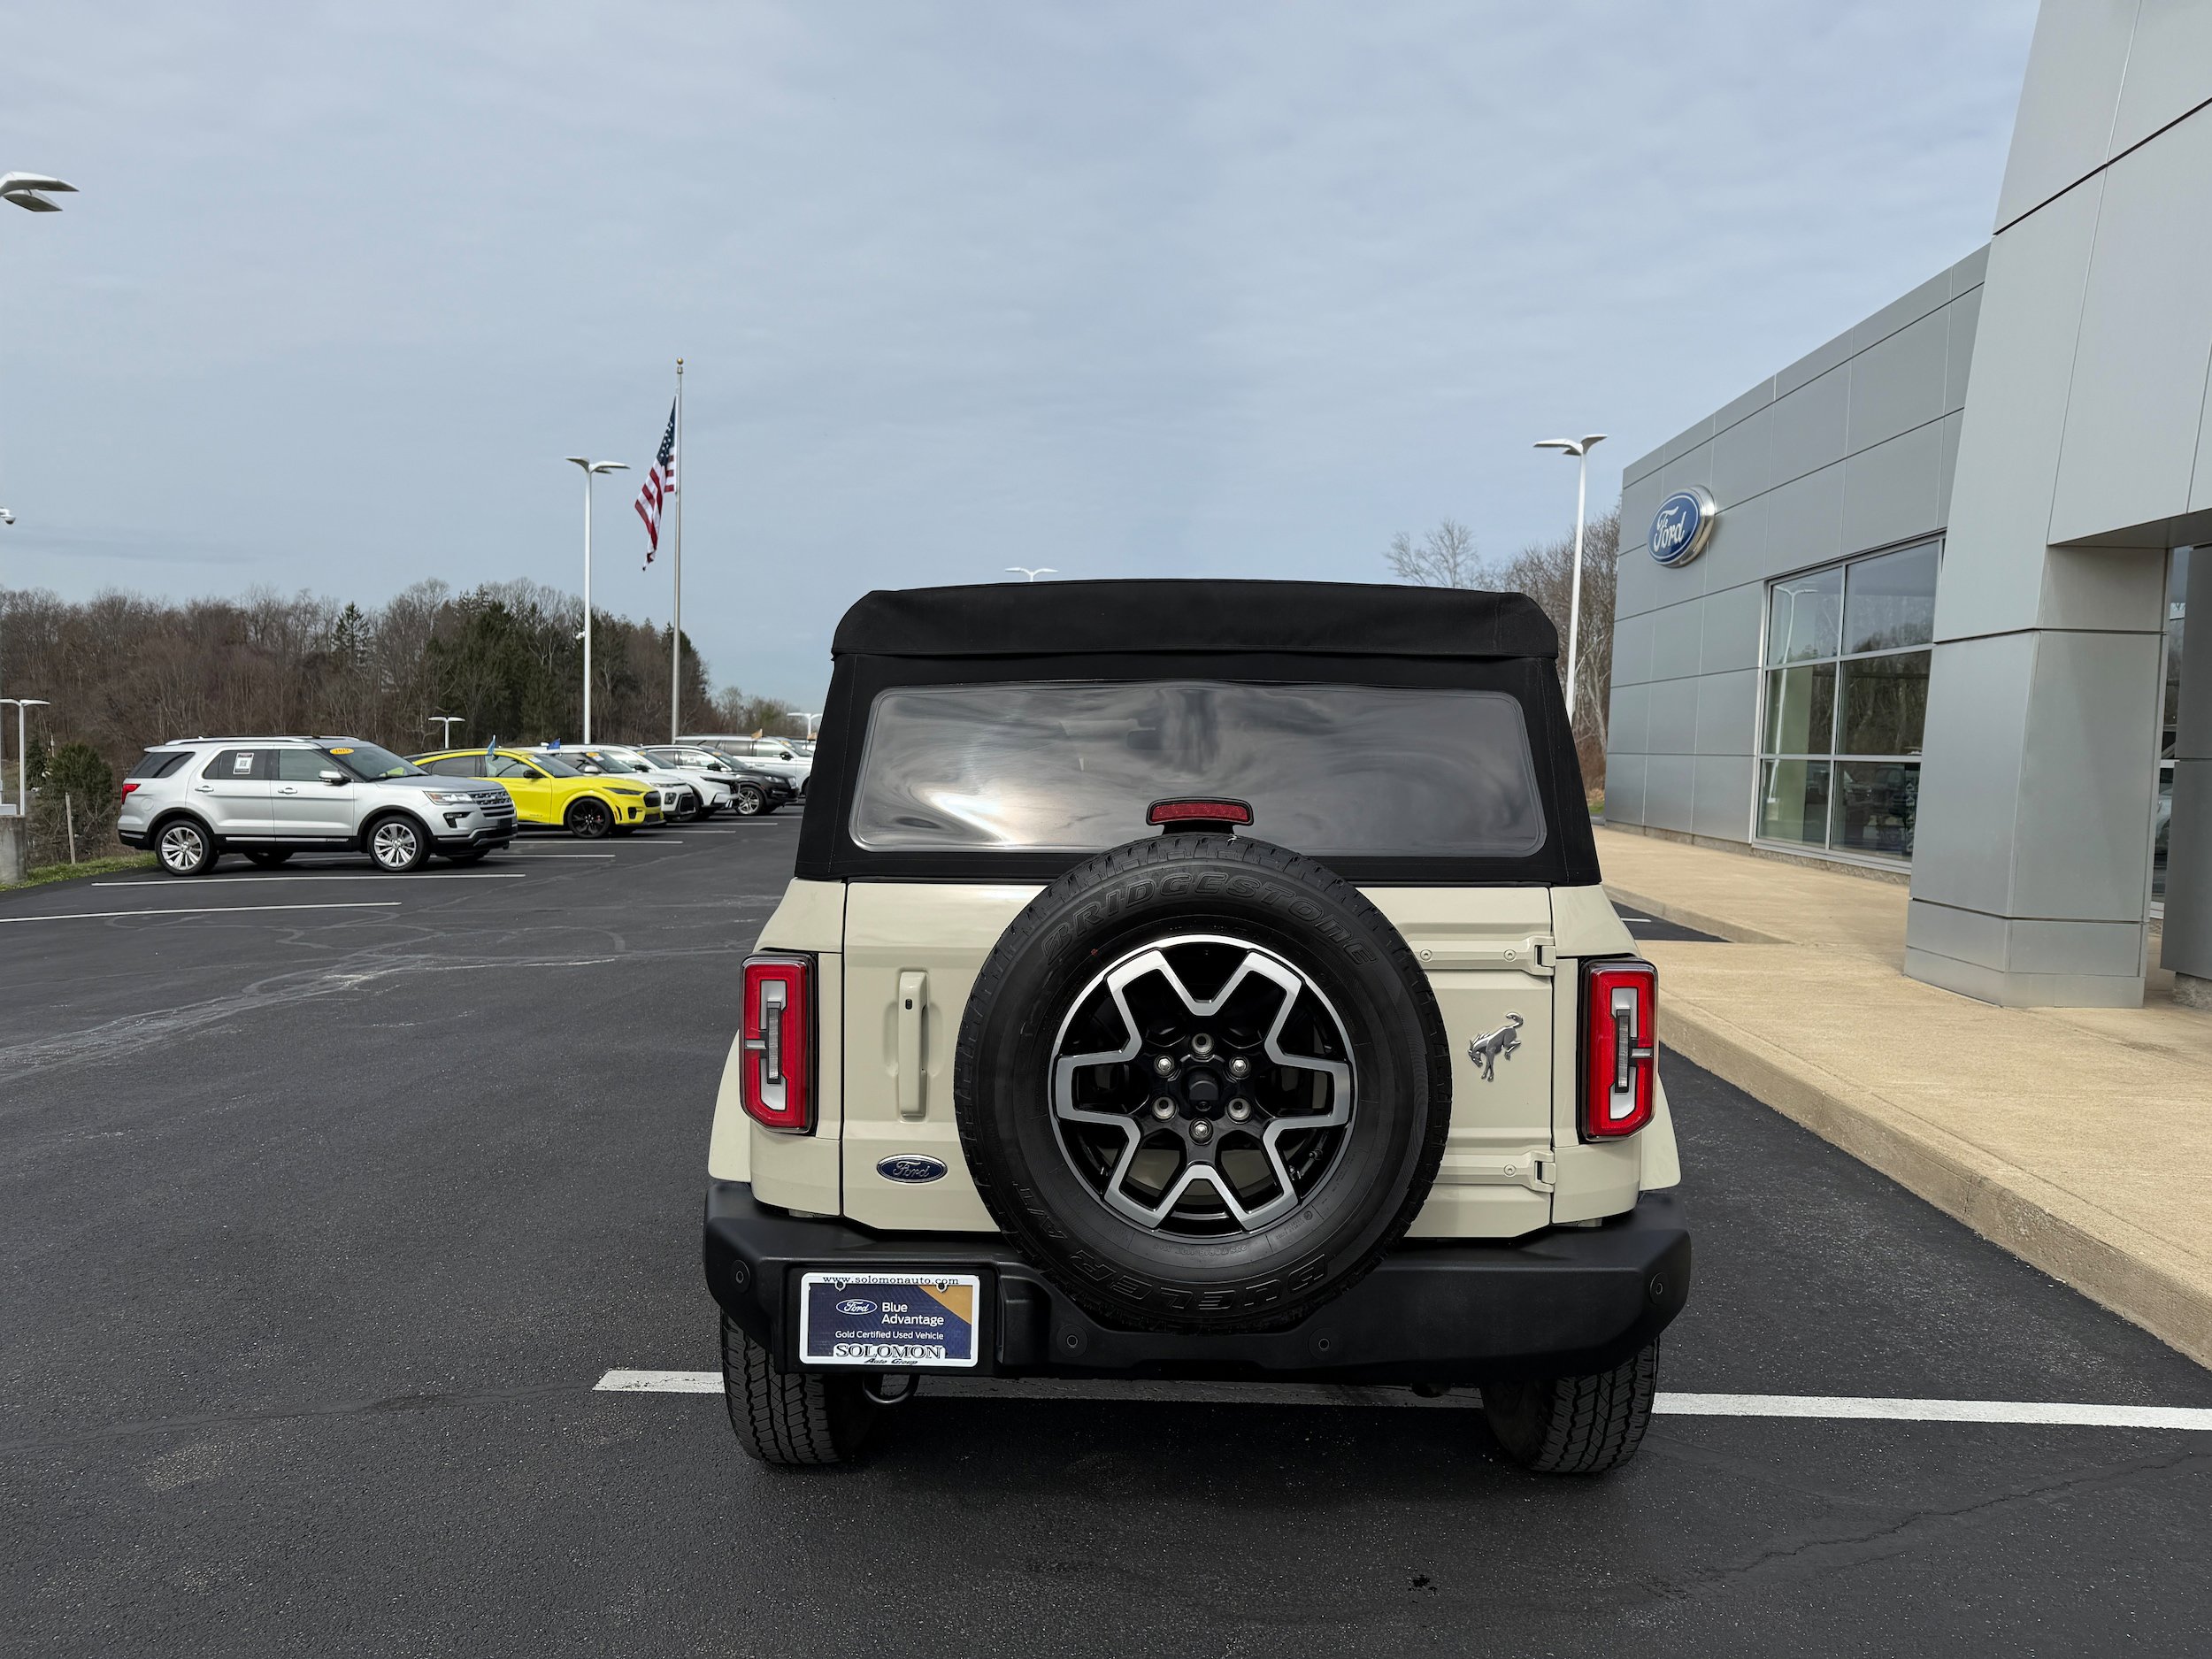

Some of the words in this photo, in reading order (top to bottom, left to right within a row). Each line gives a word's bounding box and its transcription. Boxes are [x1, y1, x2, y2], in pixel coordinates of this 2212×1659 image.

[1654, 505, 1687, 552] Ford
[1041, 871, 1378, 966] BRIDGESTONE
[893, 1161, 930, 1177] Ford
[823, 1276, 959, 1285] www.solomonauto.com
[1069, 1252, 1330, 1312] DUELER
[843, 1301, 870, 1312] Ford
[881, 1302, 908, 1313] Blue
[881, 1314, 944, 1326] Advantage
[835, 1330, 855, 1339] Gold
[856, 1330, 891, 1339] Certified
[915, 1331, 944, 1340] Vehicle
[835, 1343, 942, 1359] SOLOMON
